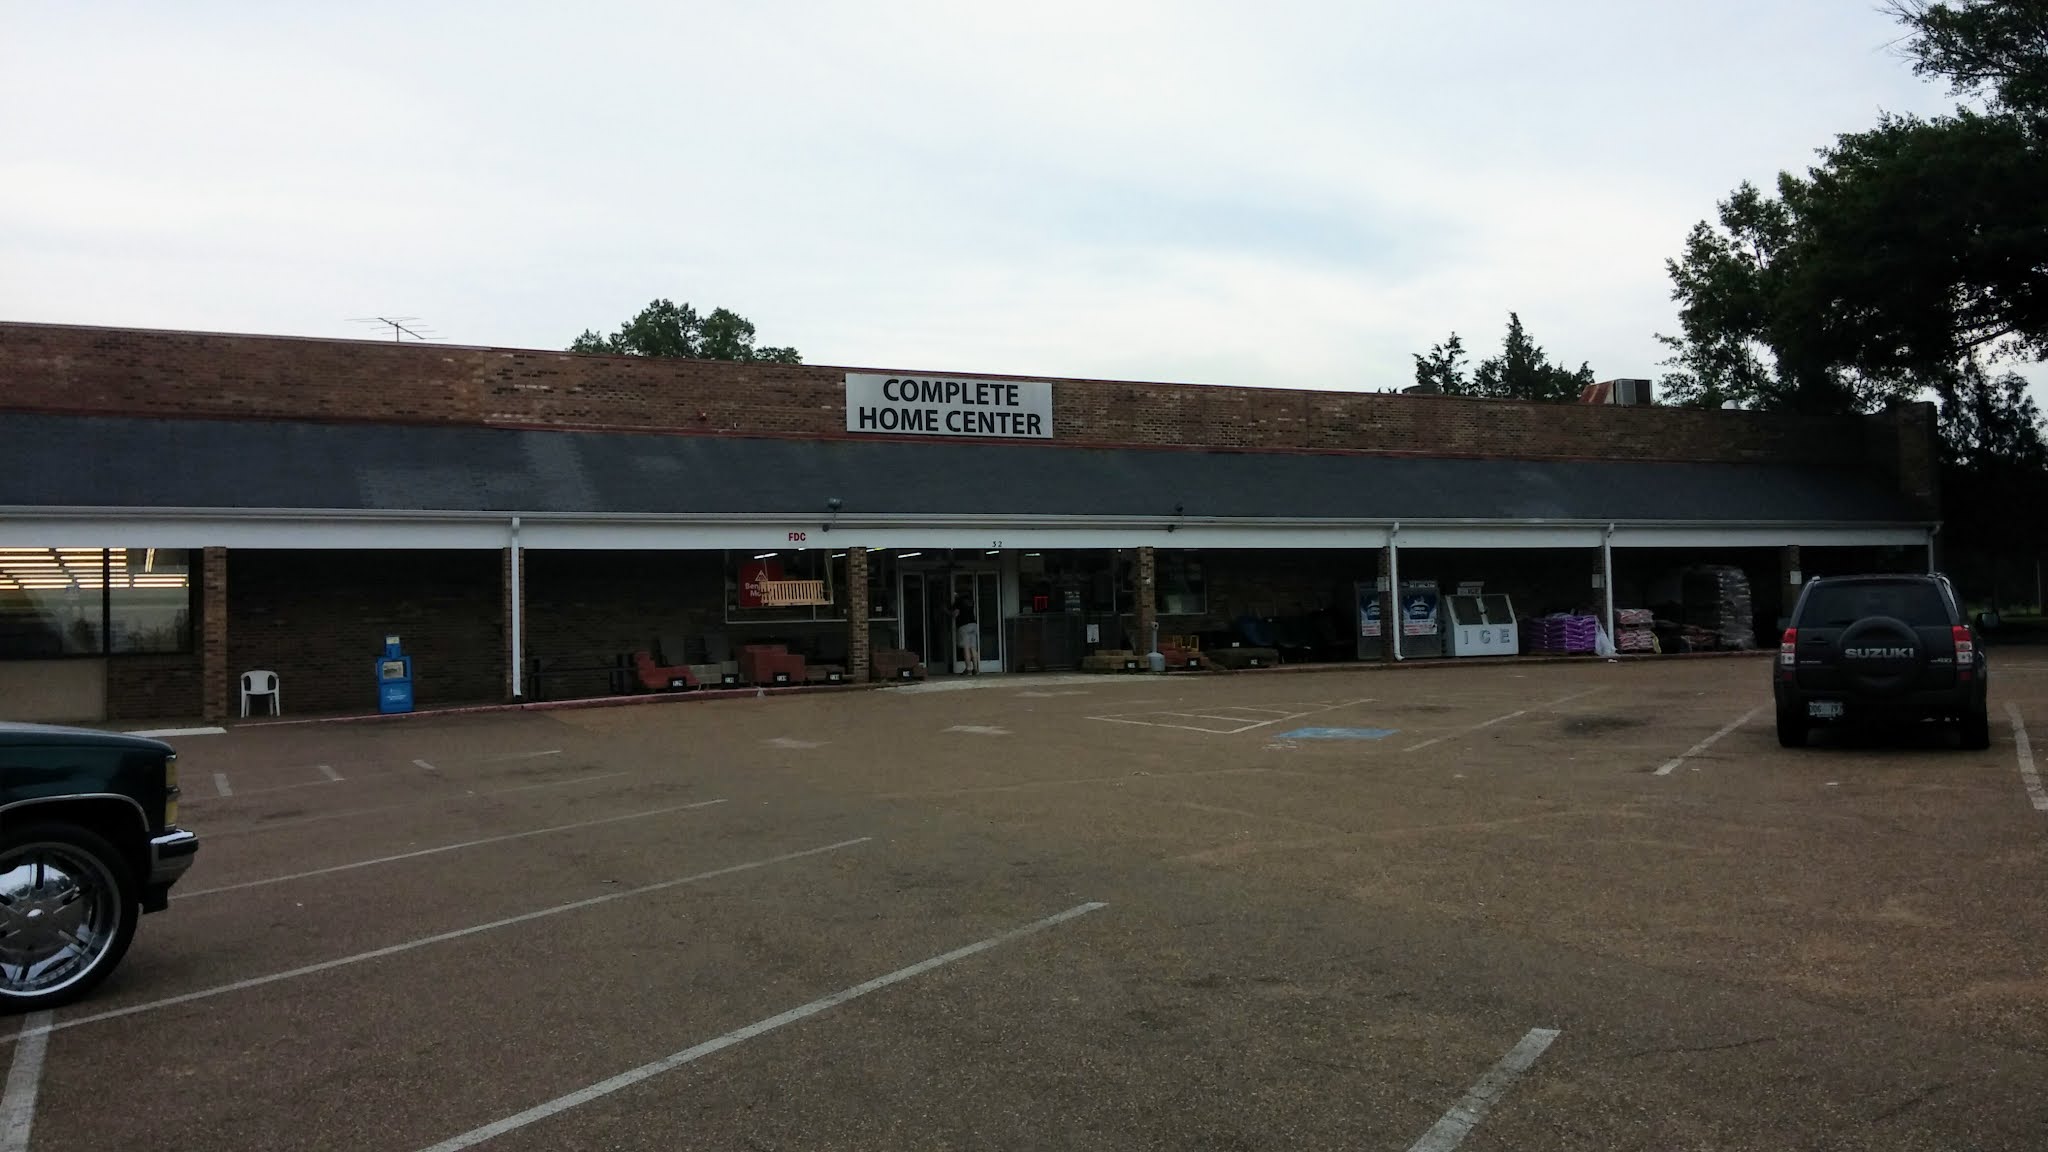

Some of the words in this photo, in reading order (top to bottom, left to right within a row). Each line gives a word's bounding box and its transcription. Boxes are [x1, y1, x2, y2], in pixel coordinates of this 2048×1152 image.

[883, 378, 1019, 406] COMPLETE
[859, 406, 938, 431] HOME
[945, 410, 1042, 435] CENTER
[788, 533, 806, 542] FDC
[1464, 629, 1510, 644] ICE
[1844, 647, 1915, 659] SUZUKI
